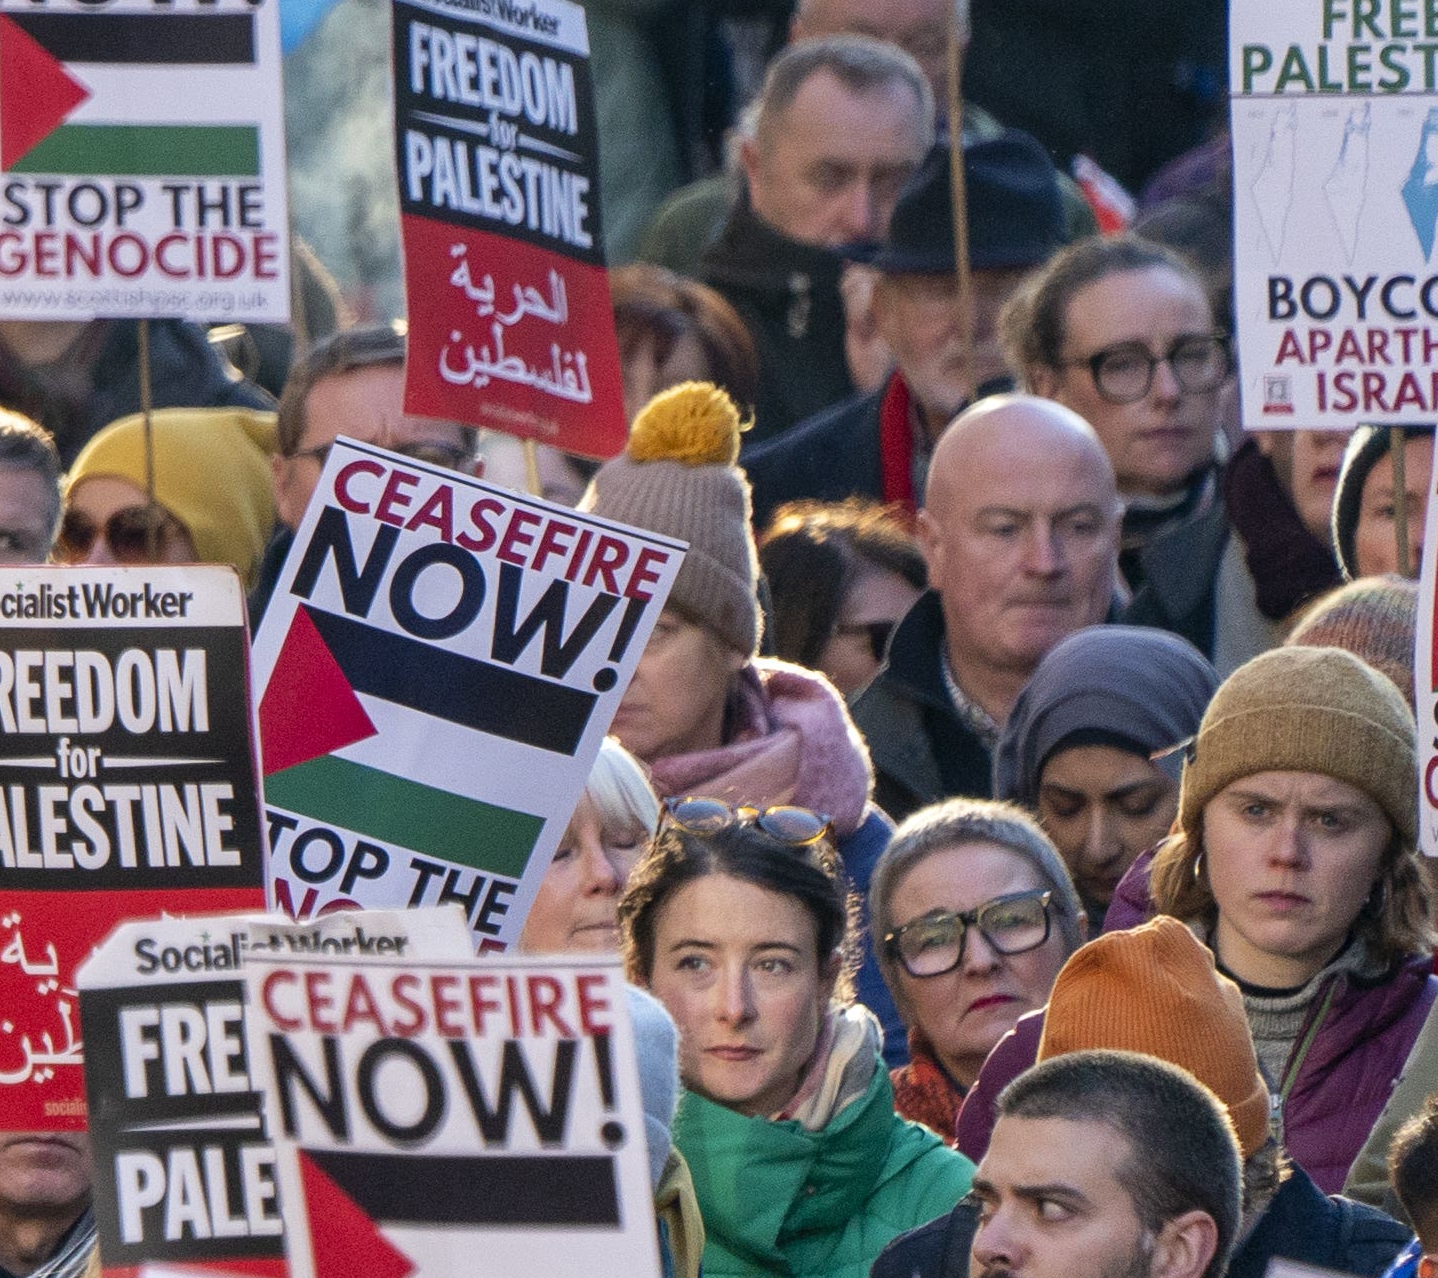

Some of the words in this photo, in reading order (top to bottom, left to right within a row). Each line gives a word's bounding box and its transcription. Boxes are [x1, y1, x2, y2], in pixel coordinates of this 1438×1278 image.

[408, 19, 578, 136] FREEDOM
[486, 114, 520, 151] for
[2, 181, 141, 230] STOP
[158, 183, 263, 230] THE
[405, 130, 593, 249] PALESTINE
[332, 446, 671, 605] CEASEFIRE
[289, 505, 656, 695] NOW!
[57, 737, 102, 778] for
[407, 858, 517, 935] THE
[261, 971, 608, 1038] CEASEFIRE
[264, 1031, 627, 1153] NOW!
